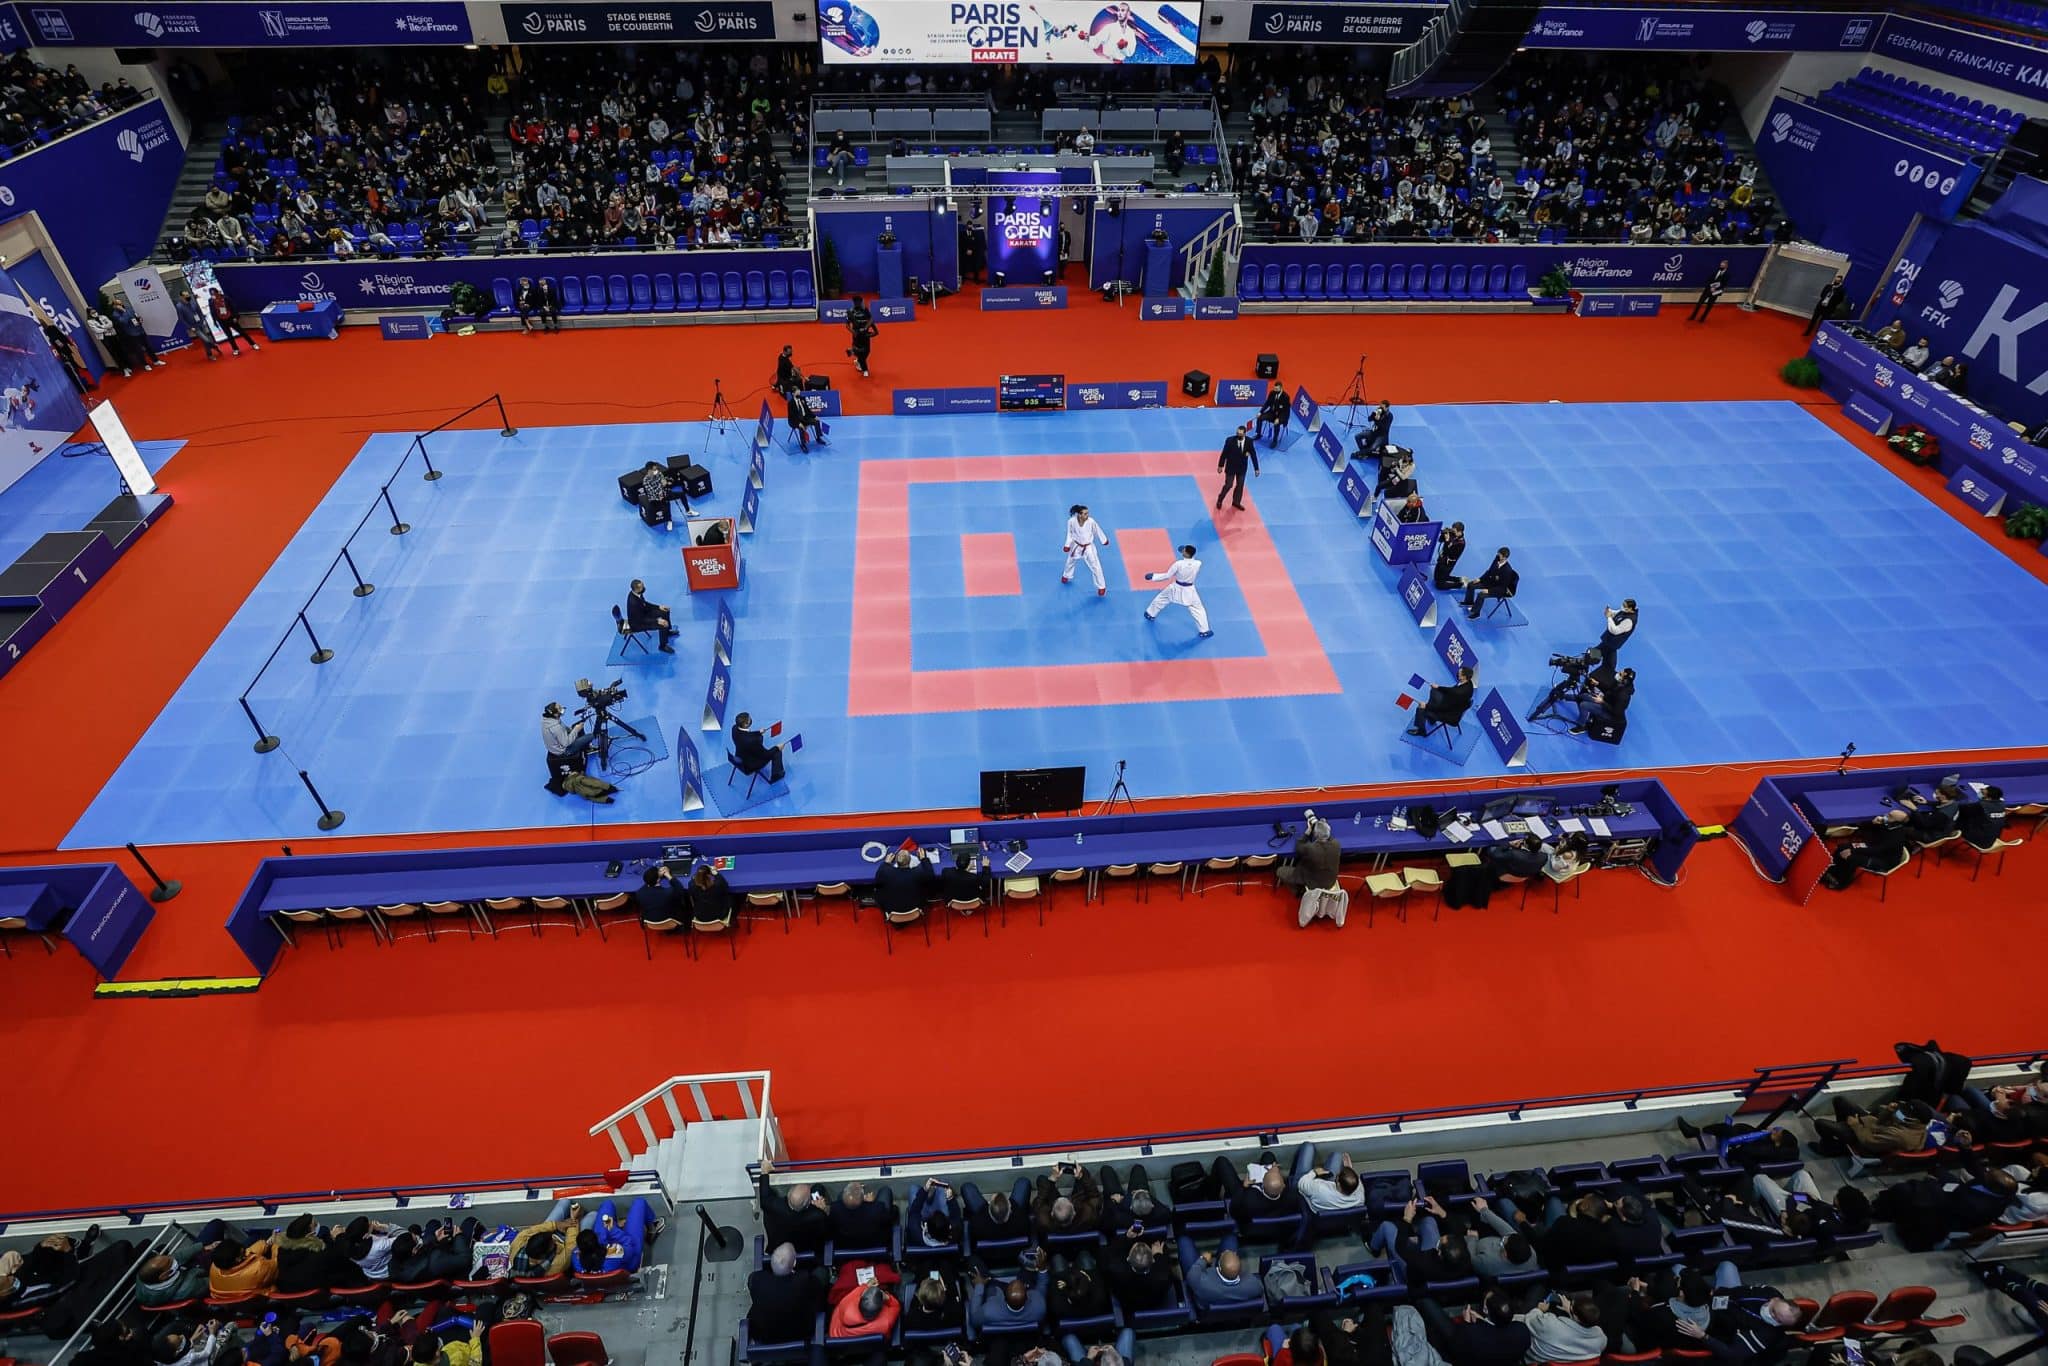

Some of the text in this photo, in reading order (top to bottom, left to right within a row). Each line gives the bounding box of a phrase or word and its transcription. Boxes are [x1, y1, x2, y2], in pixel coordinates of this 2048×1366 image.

[606, 12, 672, 22] STADE PIERRE
[951, 3, 1020, 24] PARIS
[407, 15, 434, 25] Région
[547, 18, 587, 33] PARIS
[719, 16, 758, 31] PARIS
[1344, 16, 1403, 25] STADE PIERRE
[608, 22, 673, 32] DE COUBERTIN
[1286, 20, 1322, 33] PARIS
[1343, 25, 1401, 34] DE COUBERTIN
[967, 26, 1038, 48] OPEN
[1887, 33, 1945, 57] FÉDÉRATION
[974, 50, 1015, 61] KARATE
[995, 212, 1040, 226] PARIS
[1005, 225, 1052, 240] OPEN
[1576, 257, 1608, 268] Région
[375, 274, 414, 286] Région
[1652, 271, 1684, 281] PARIS
[1919, 306, 1952, 329] FFK
[295, 323, 313, 331] FFK
[1874, 362, 1894, 377] PARIS
[1079, 388, 1099, 396] PARIS
[1230, 384, 1251, 392] PARIS
[1969, 422, 1993, 441] PARIS
[1404, 533, 1428, 542] PARIS
[691, 558, 718, 568] PARIS
[73, 567, 88, 584] 1
[1448, 633, 1465, 655] PARIS
[7, 643, 21, 660] 2
